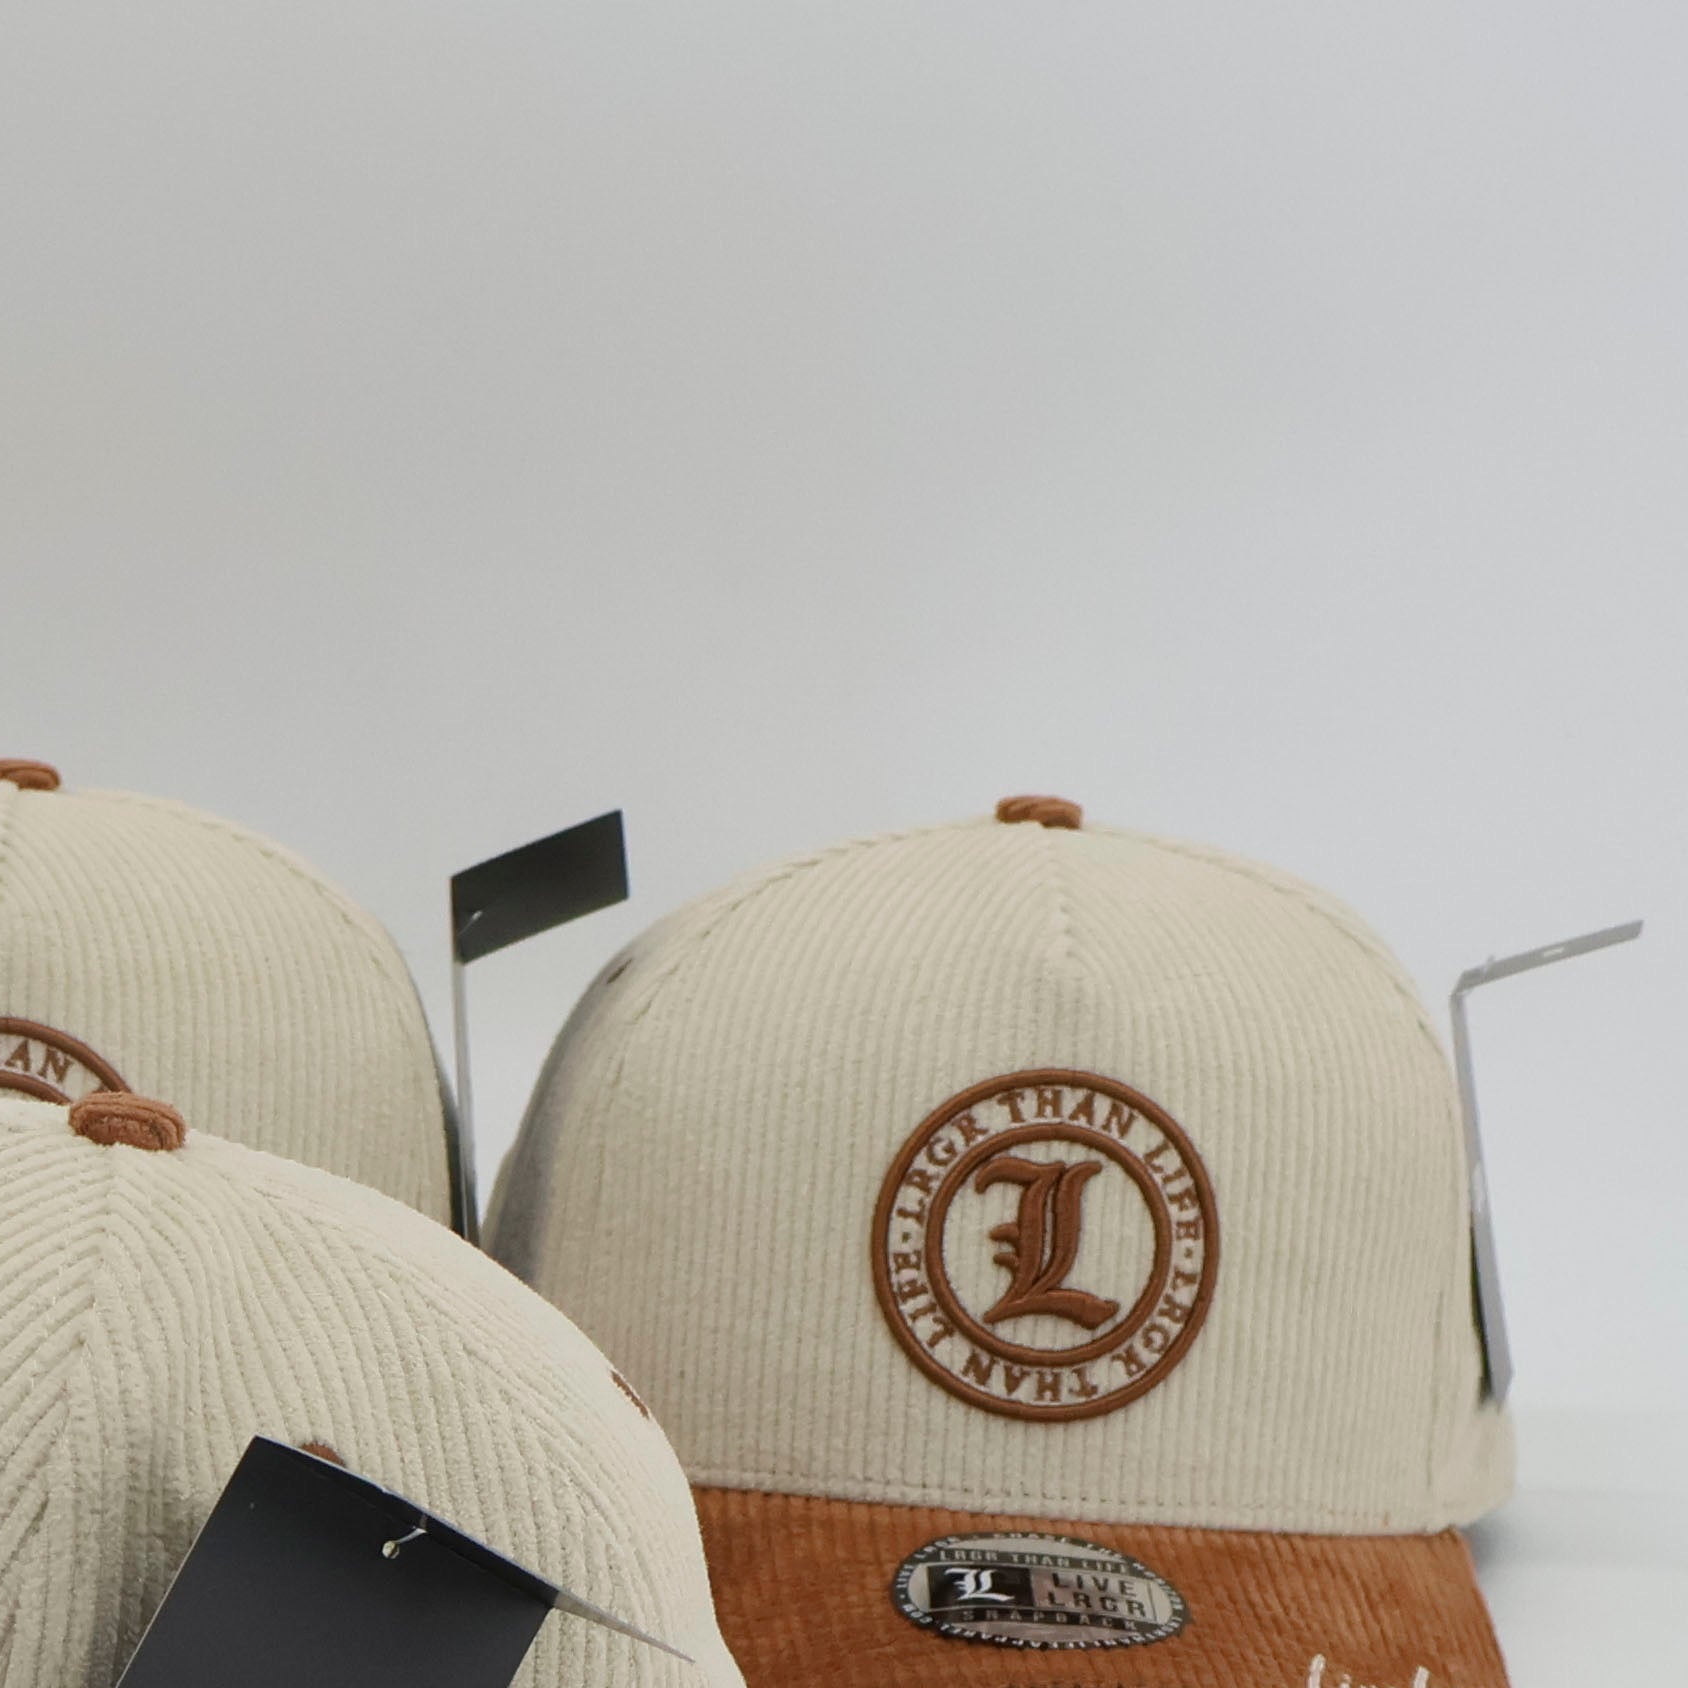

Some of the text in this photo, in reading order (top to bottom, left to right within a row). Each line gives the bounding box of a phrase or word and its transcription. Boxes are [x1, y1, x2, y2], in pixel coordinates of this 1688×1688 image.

[897, 1088, 1200, 1241] LRGR THAN LIFE
[974, 1156, 1120, 1330] L
[893, 1250, 1197, 1401] LRGR THAN LIFE
[1048, 1592, 1146, 1617] LRGR
[1051, 1572, 1137, 1597] LIVE
